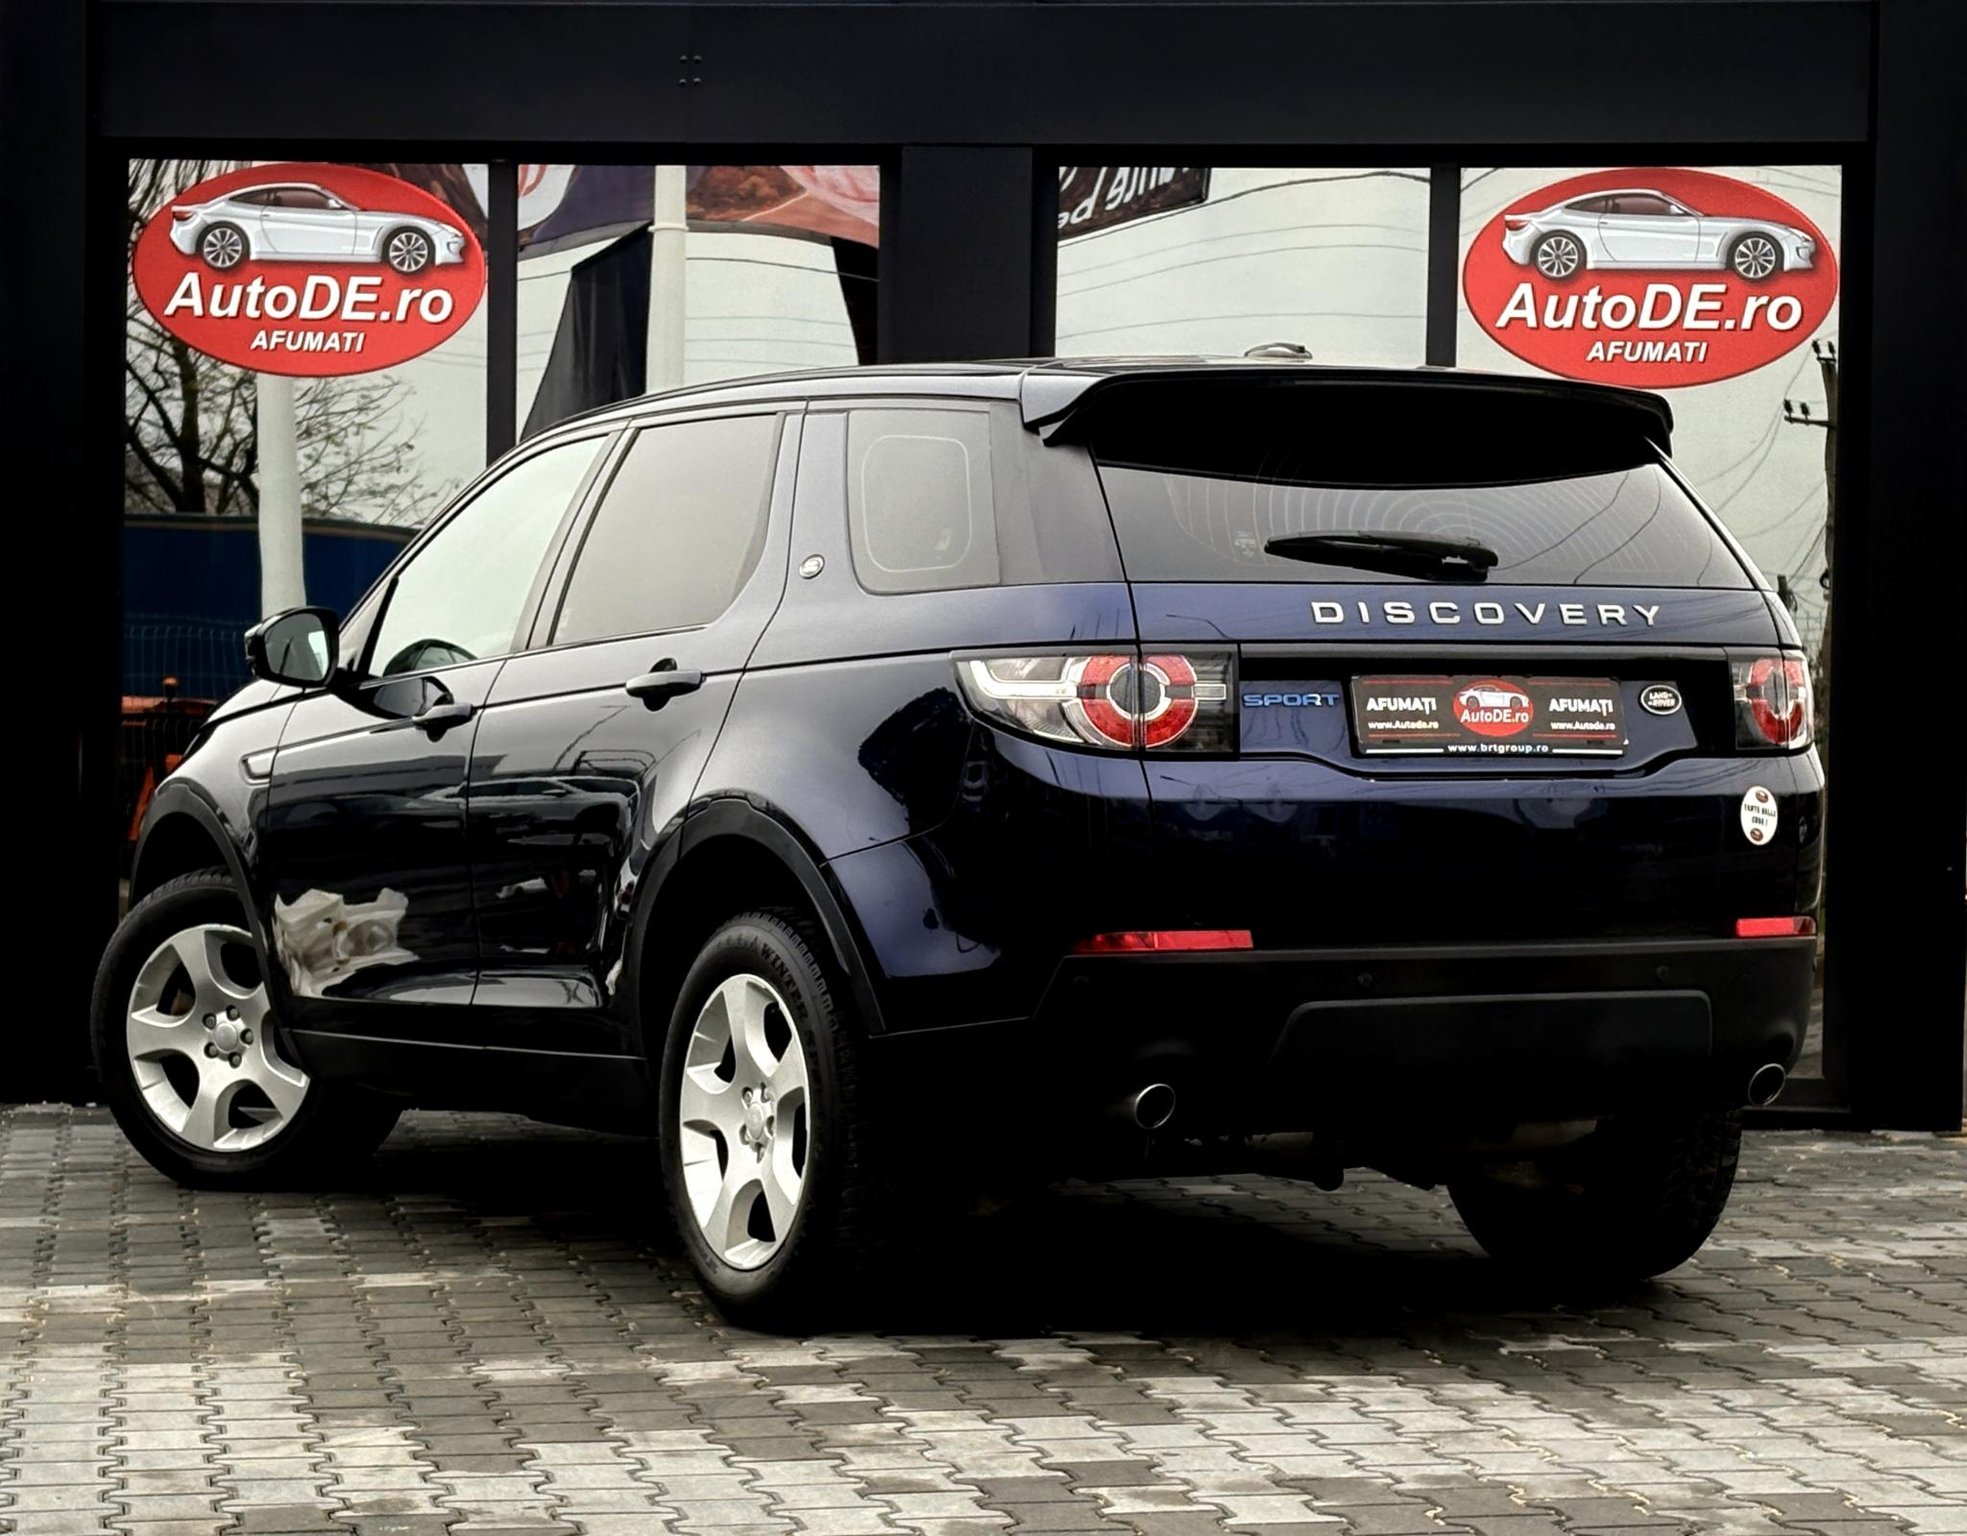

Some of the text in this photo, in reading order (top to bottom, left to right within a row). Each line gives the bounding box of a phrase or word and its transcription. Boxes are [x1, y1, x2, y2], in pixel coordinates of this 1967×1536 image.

[164, 271, 453, 323] AutoDE.ro
[1495, 282, 1802, 330] AutoDE.ro
[250, 329, 366, 353] AFUMATI
[1585, 340, 1708, 363] AFUMATI
[1311, 601, 1660, 627] DISCOVERY
[1243, 693, 1340, 707] SPORT
[1460, 709, 1530, 724] AutoDE.ro
[1447, 743, 1550, 754] www.brtgroup.ro
